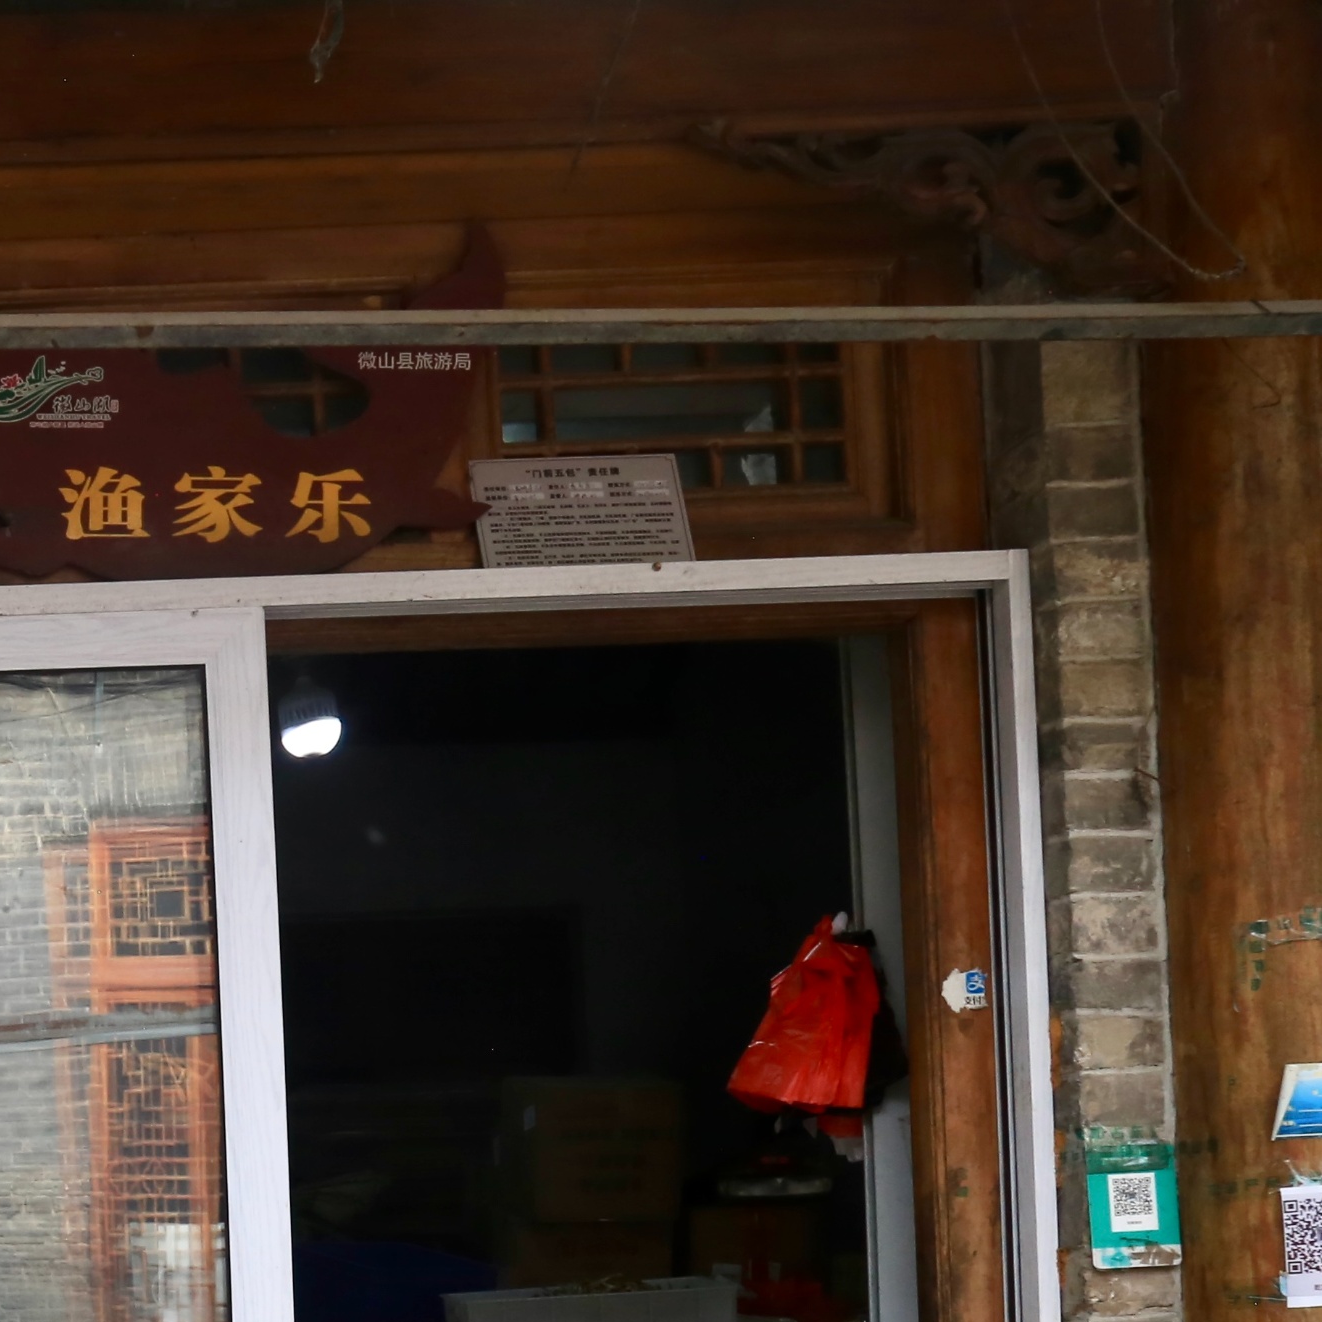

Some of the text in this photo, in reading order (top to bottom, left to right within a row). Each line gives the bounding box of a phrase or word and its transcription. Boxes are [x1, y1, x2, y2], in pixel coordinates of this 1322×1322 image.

[358, 352, 472, 370] 微山县旅游局
[59, 466, 372, 543] 渔家乐
